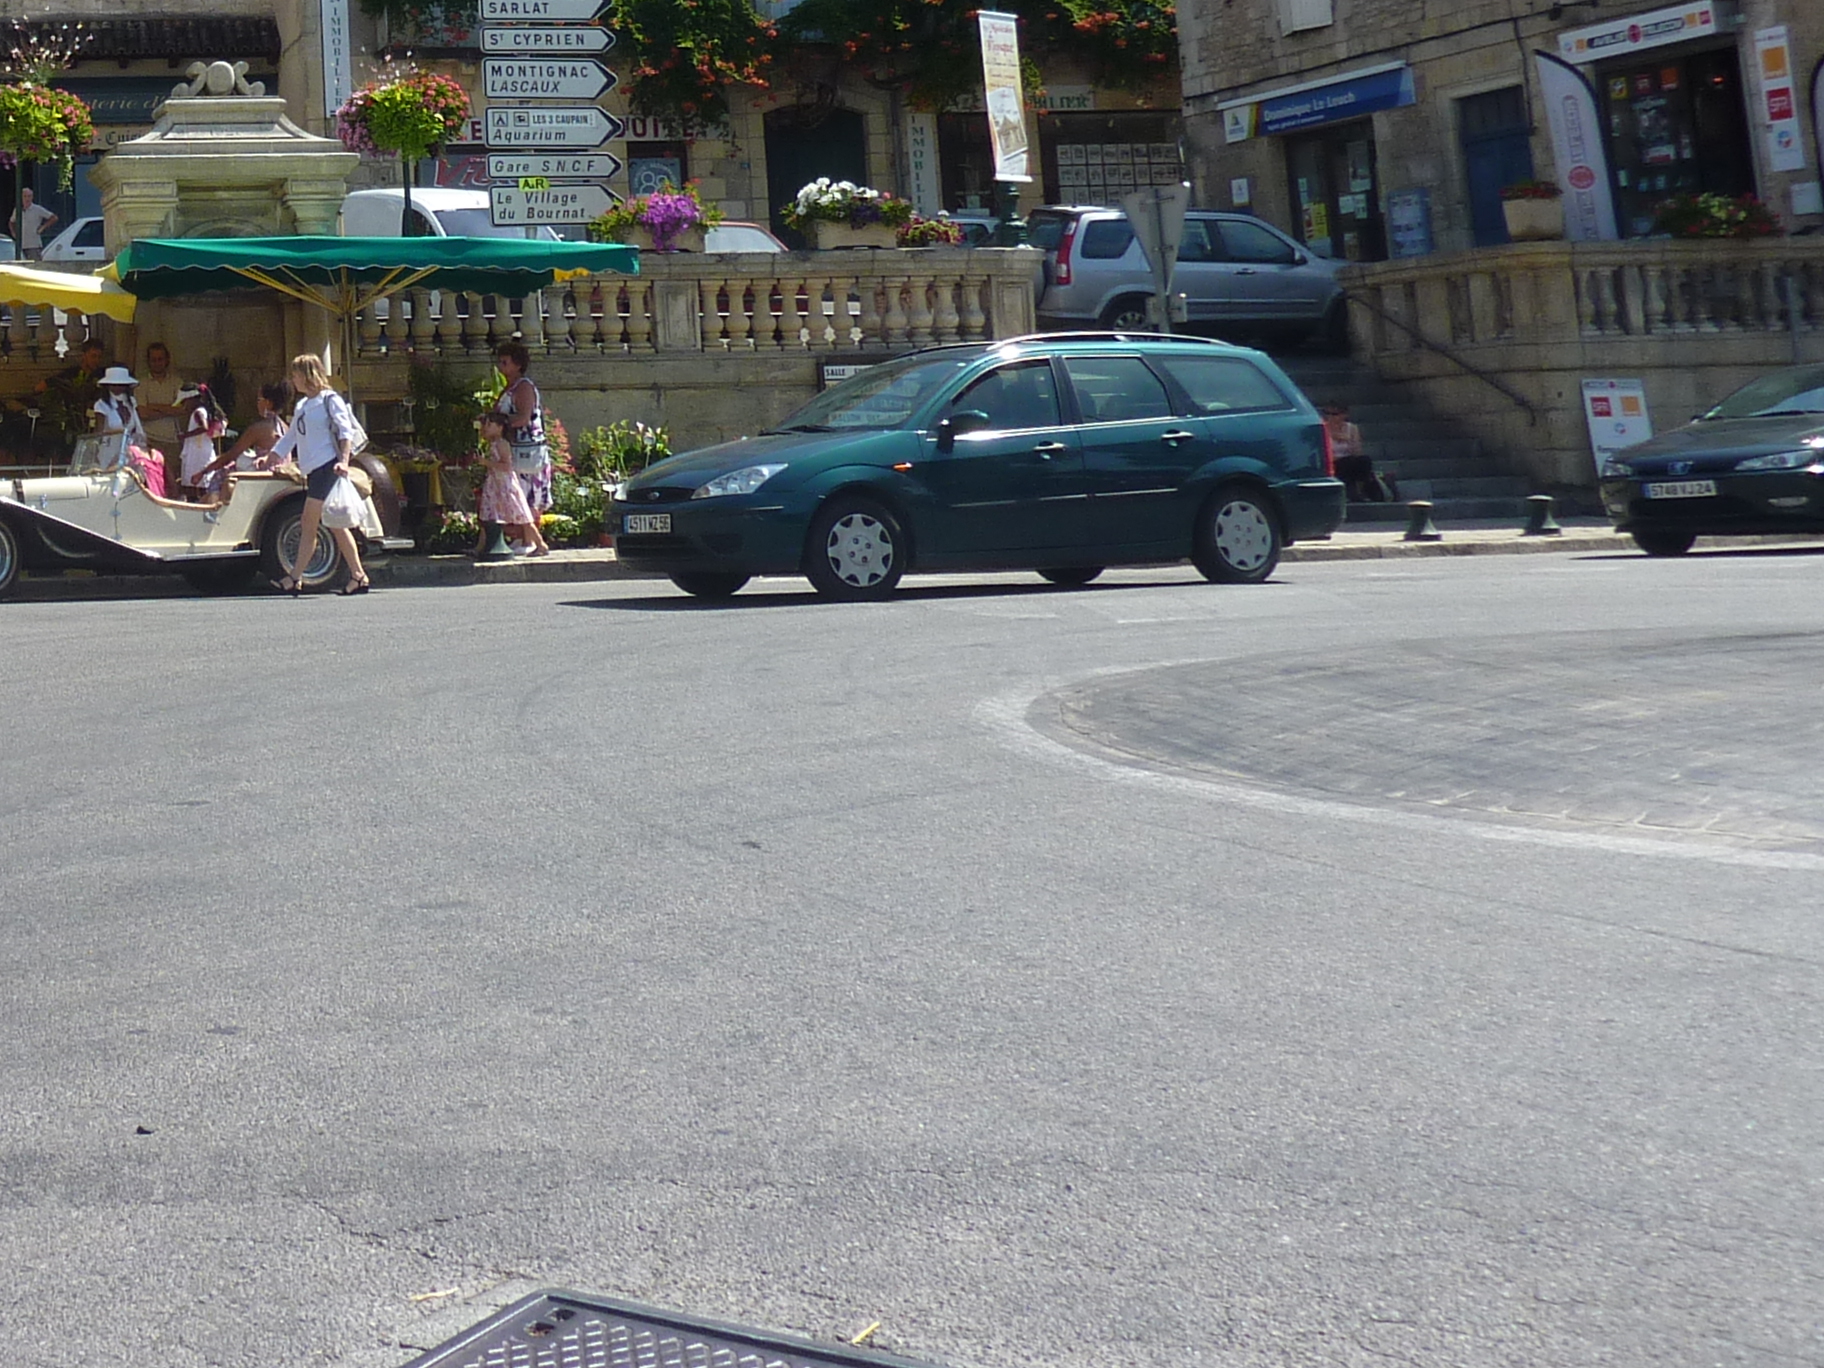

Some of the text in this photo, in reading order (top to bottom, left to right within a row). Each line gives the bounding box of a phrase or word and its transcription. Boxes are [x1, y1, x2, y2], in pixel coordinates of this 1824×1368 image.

[489, 2, 550, 14] SARLAT
[513, 34, 585, 45] CYPRIEN
[491, 66, 589, 78] MONTIGNAC
[491, 81, 561, 92] LASCAUX
[532, 115, 546, 125] LES
[548, 115, 554, 125] 3
[493, 129, 566, 143] Aquarium
[495, 160, 530, 173] Gare
[497, 191, 578, 207] Le Village
[499, 208, 515, 220] du
